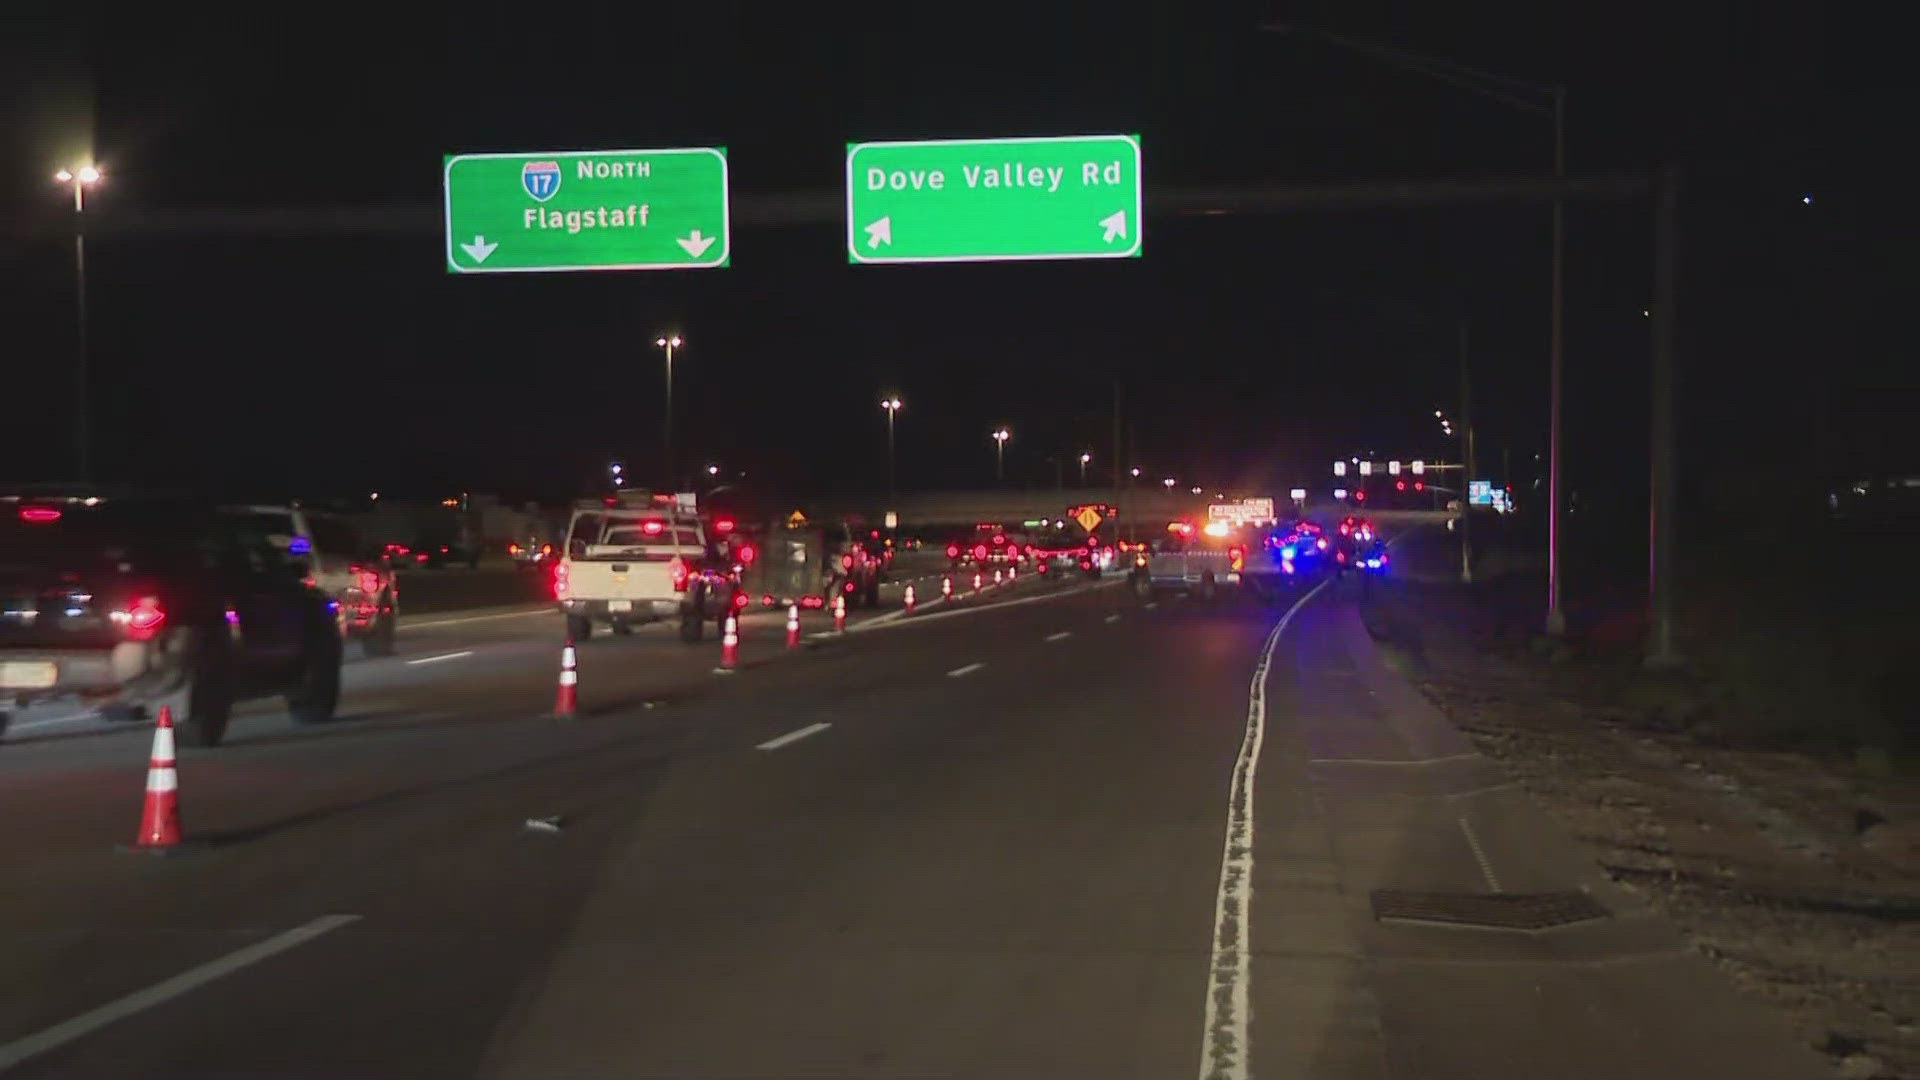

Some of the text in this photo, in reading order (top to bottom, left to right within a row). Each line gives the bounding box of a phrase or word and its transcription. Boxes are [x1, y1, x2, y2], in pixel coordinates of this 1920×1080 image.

[577, 161, 650, 179] NORTH
[867, 161, 1121, 192] Dove Valley Rd
[532, 174, 552, 195] 17
[523, 205, 649, 233] Flagstaff
